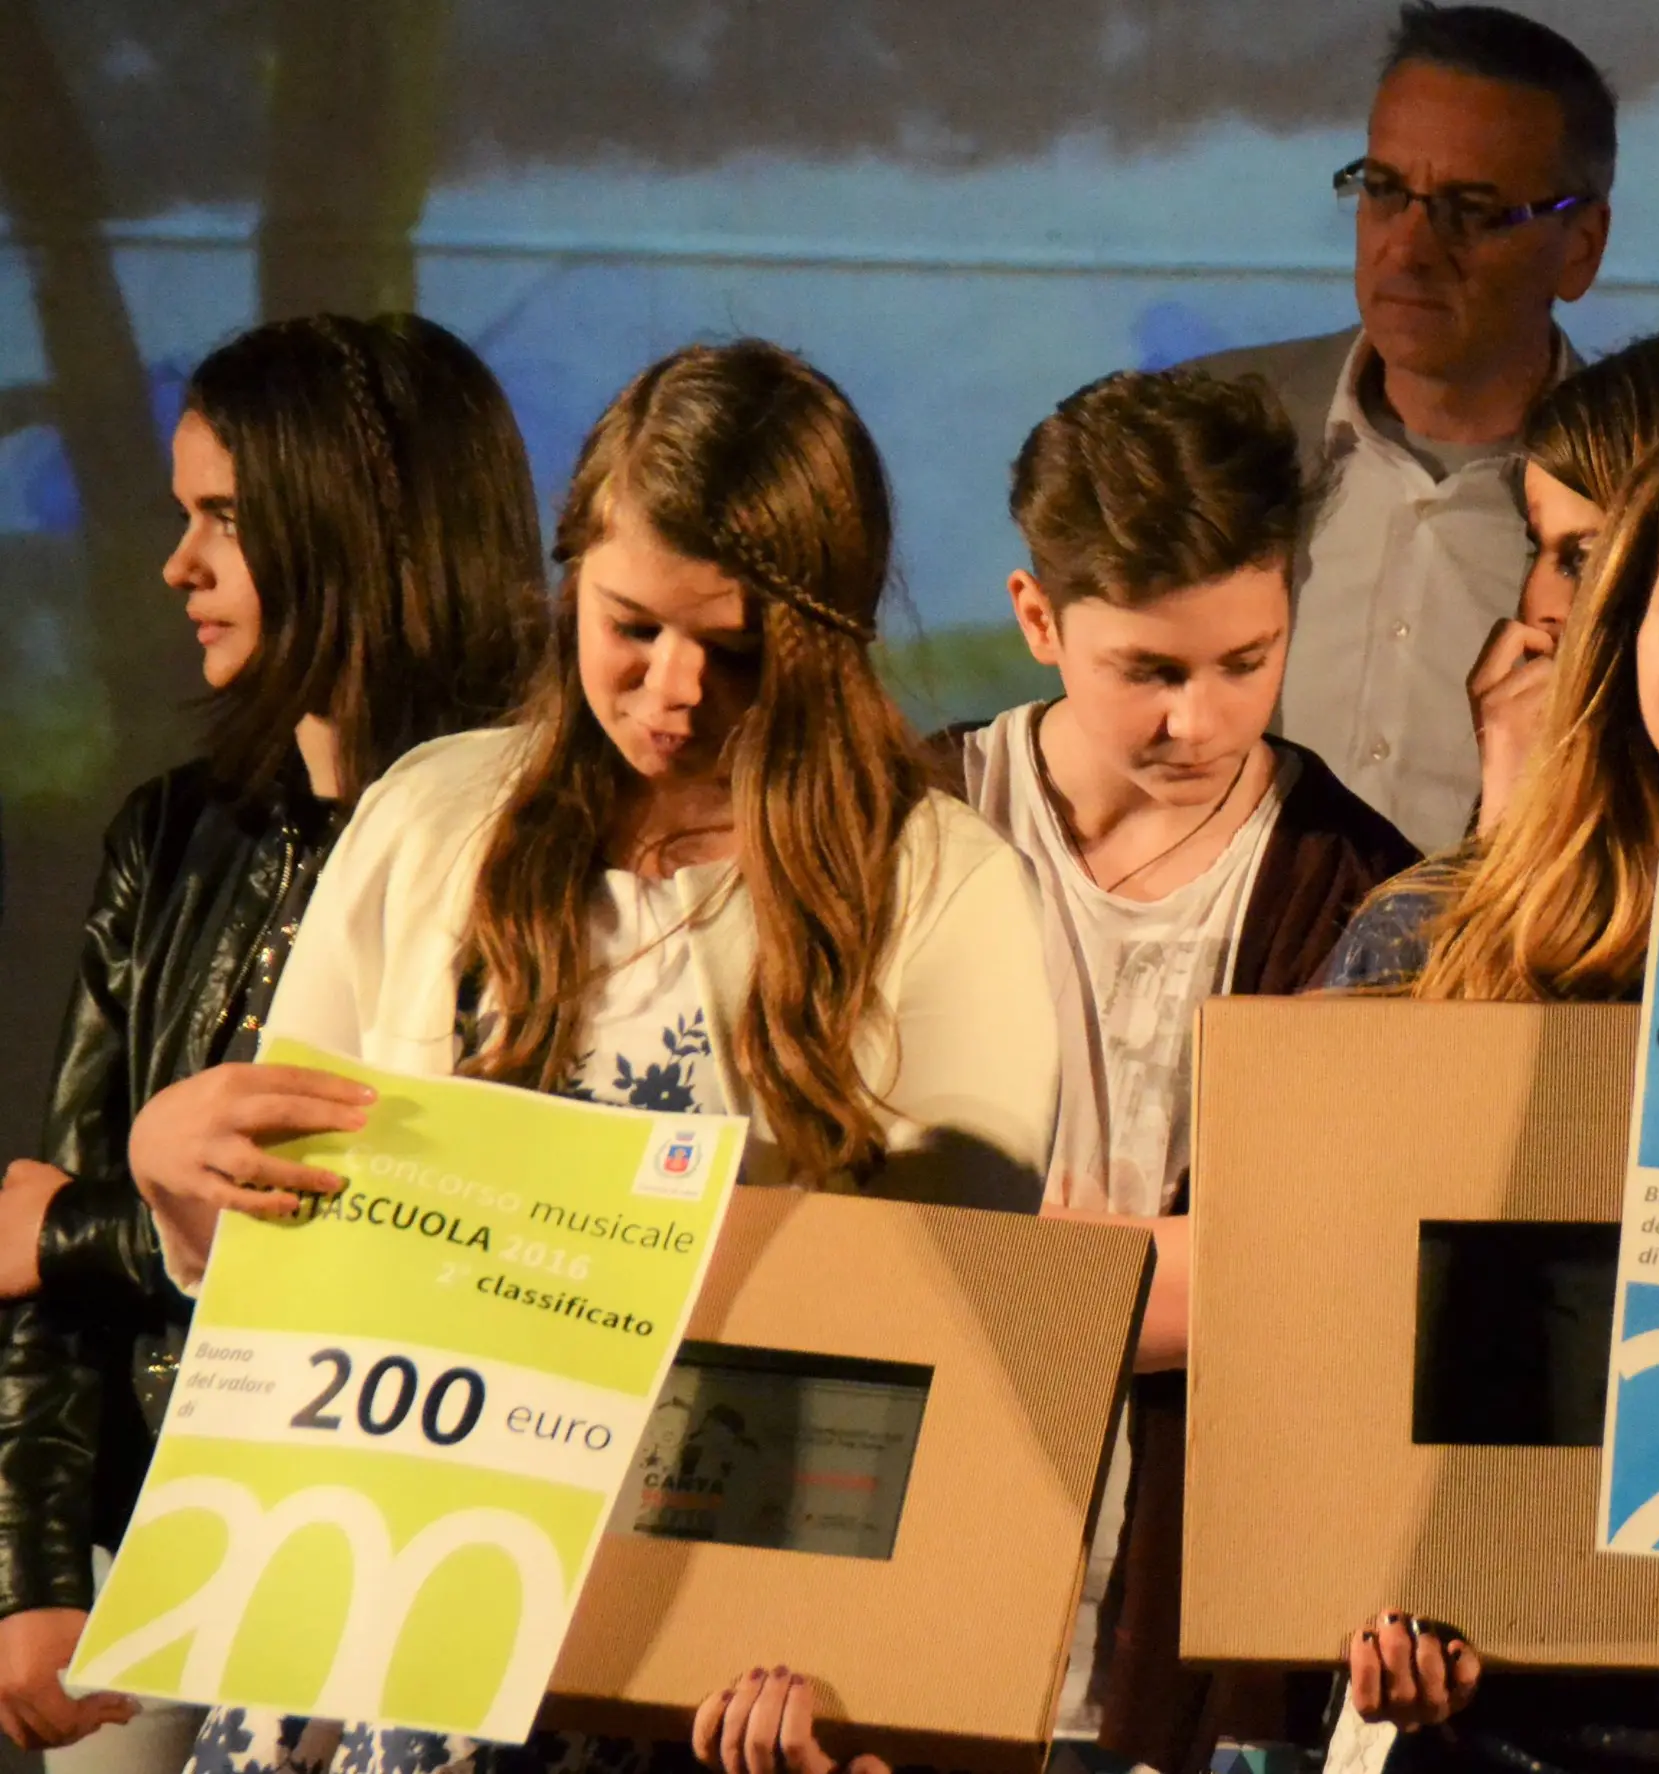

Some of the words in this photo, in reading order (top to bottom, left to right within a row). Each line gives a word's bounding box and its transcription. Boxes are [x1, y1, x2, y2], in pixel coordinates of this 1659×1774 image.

[343, 1143, 522, 1212] Concorso
[529, 1199, 696, 1255] musicale
[499, 1234, 593, 1282] 2016
[1637, 1247, 1659, 1266] di
[476, 1274, 655, 1337] classificato
[193, 1342, 254, 1363] Buono
[185, 1371, 214, 1390] del
[215, 1376, 276, 1394] valore
[289, 1347, 487, 1446] 200
[505, 1404, 613, 1451] euro
[176, 1401, 196, 1419] di
[76, 1473, 568, 1738] 200
